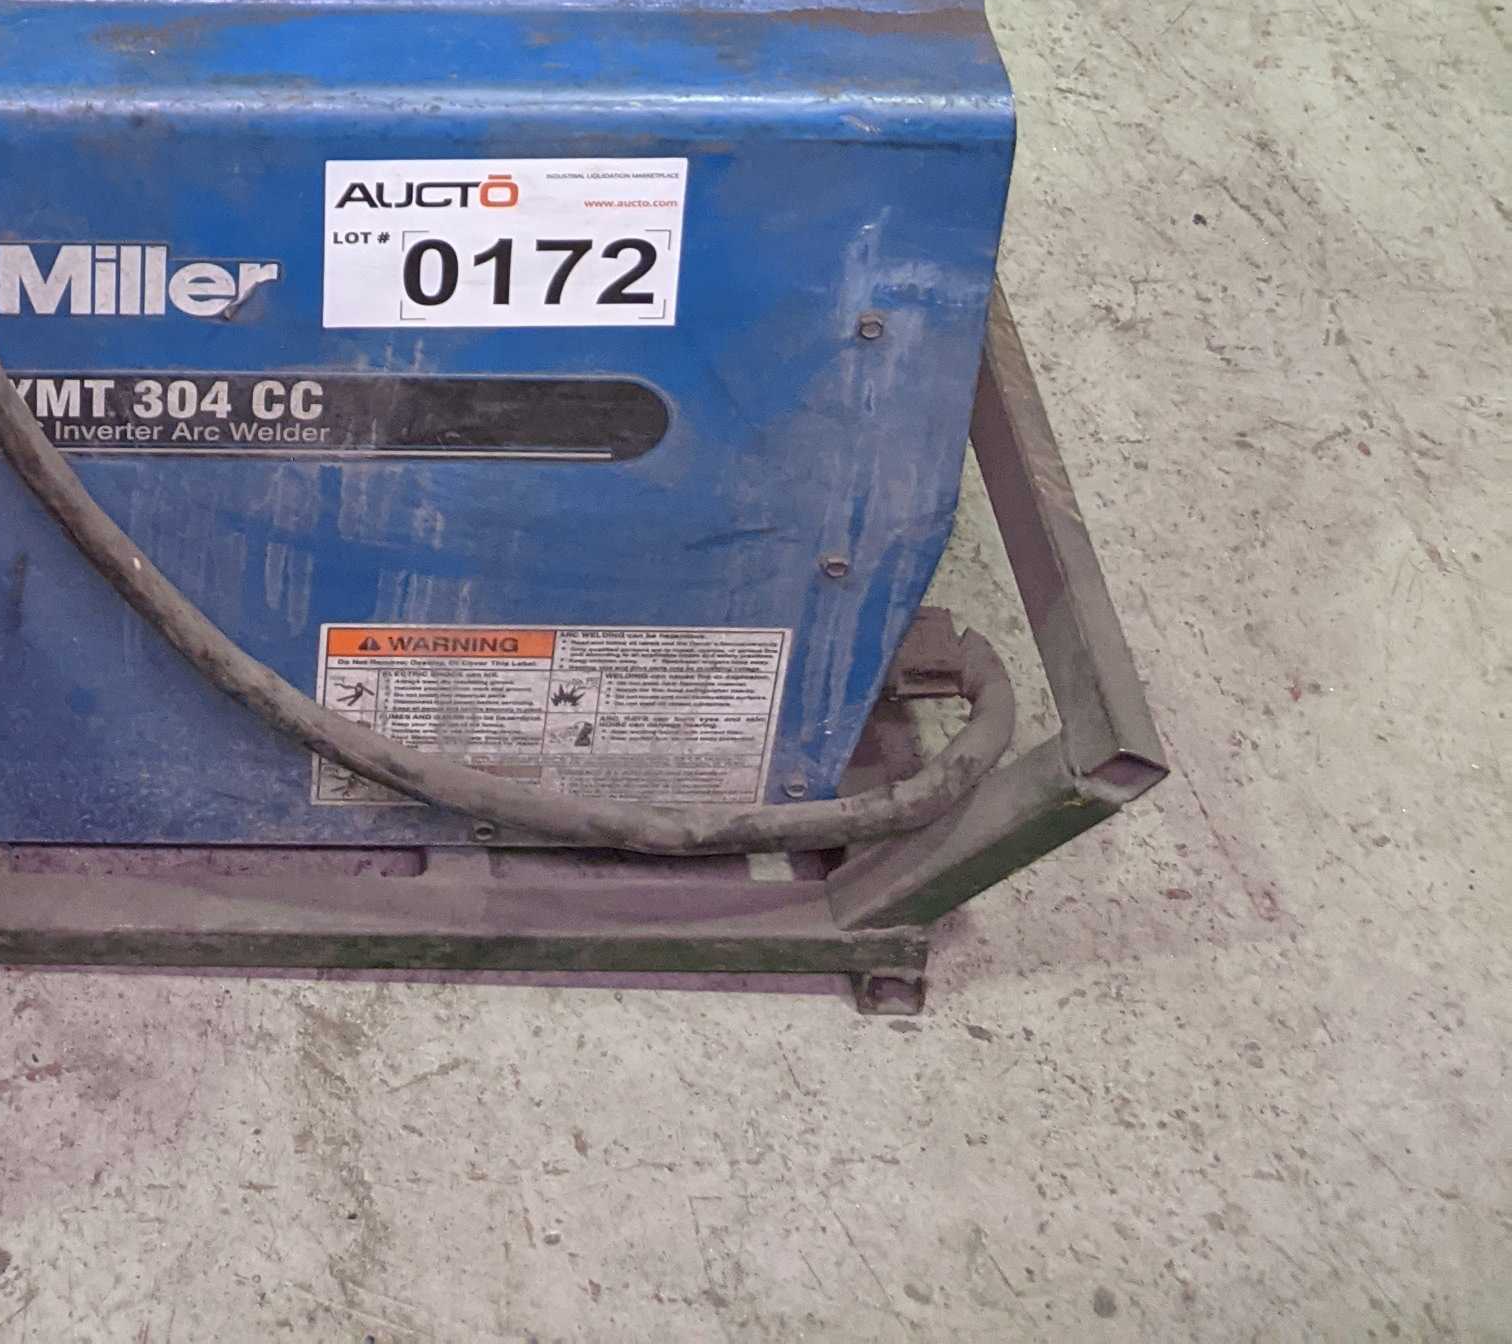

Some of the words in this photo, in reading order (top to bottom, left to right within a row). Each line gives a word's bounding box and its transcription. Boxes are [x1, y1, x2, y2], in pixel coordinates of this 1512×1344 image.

[584, 198, 678, 209] www.aucto.com
[333, 231, 372, 245] LOT
[377, 231, 390, 245] #
[403, 237, 658, 306] 0172
[133, 379, 232, 419] 304
[252, 380, 324, 420] CC
[55, 421, 161, 442] Inverter
[171, 422, 220, 442] Arc
[230, 422, 331, 442] Welder
[388, 636, 519, 653] WARNING
